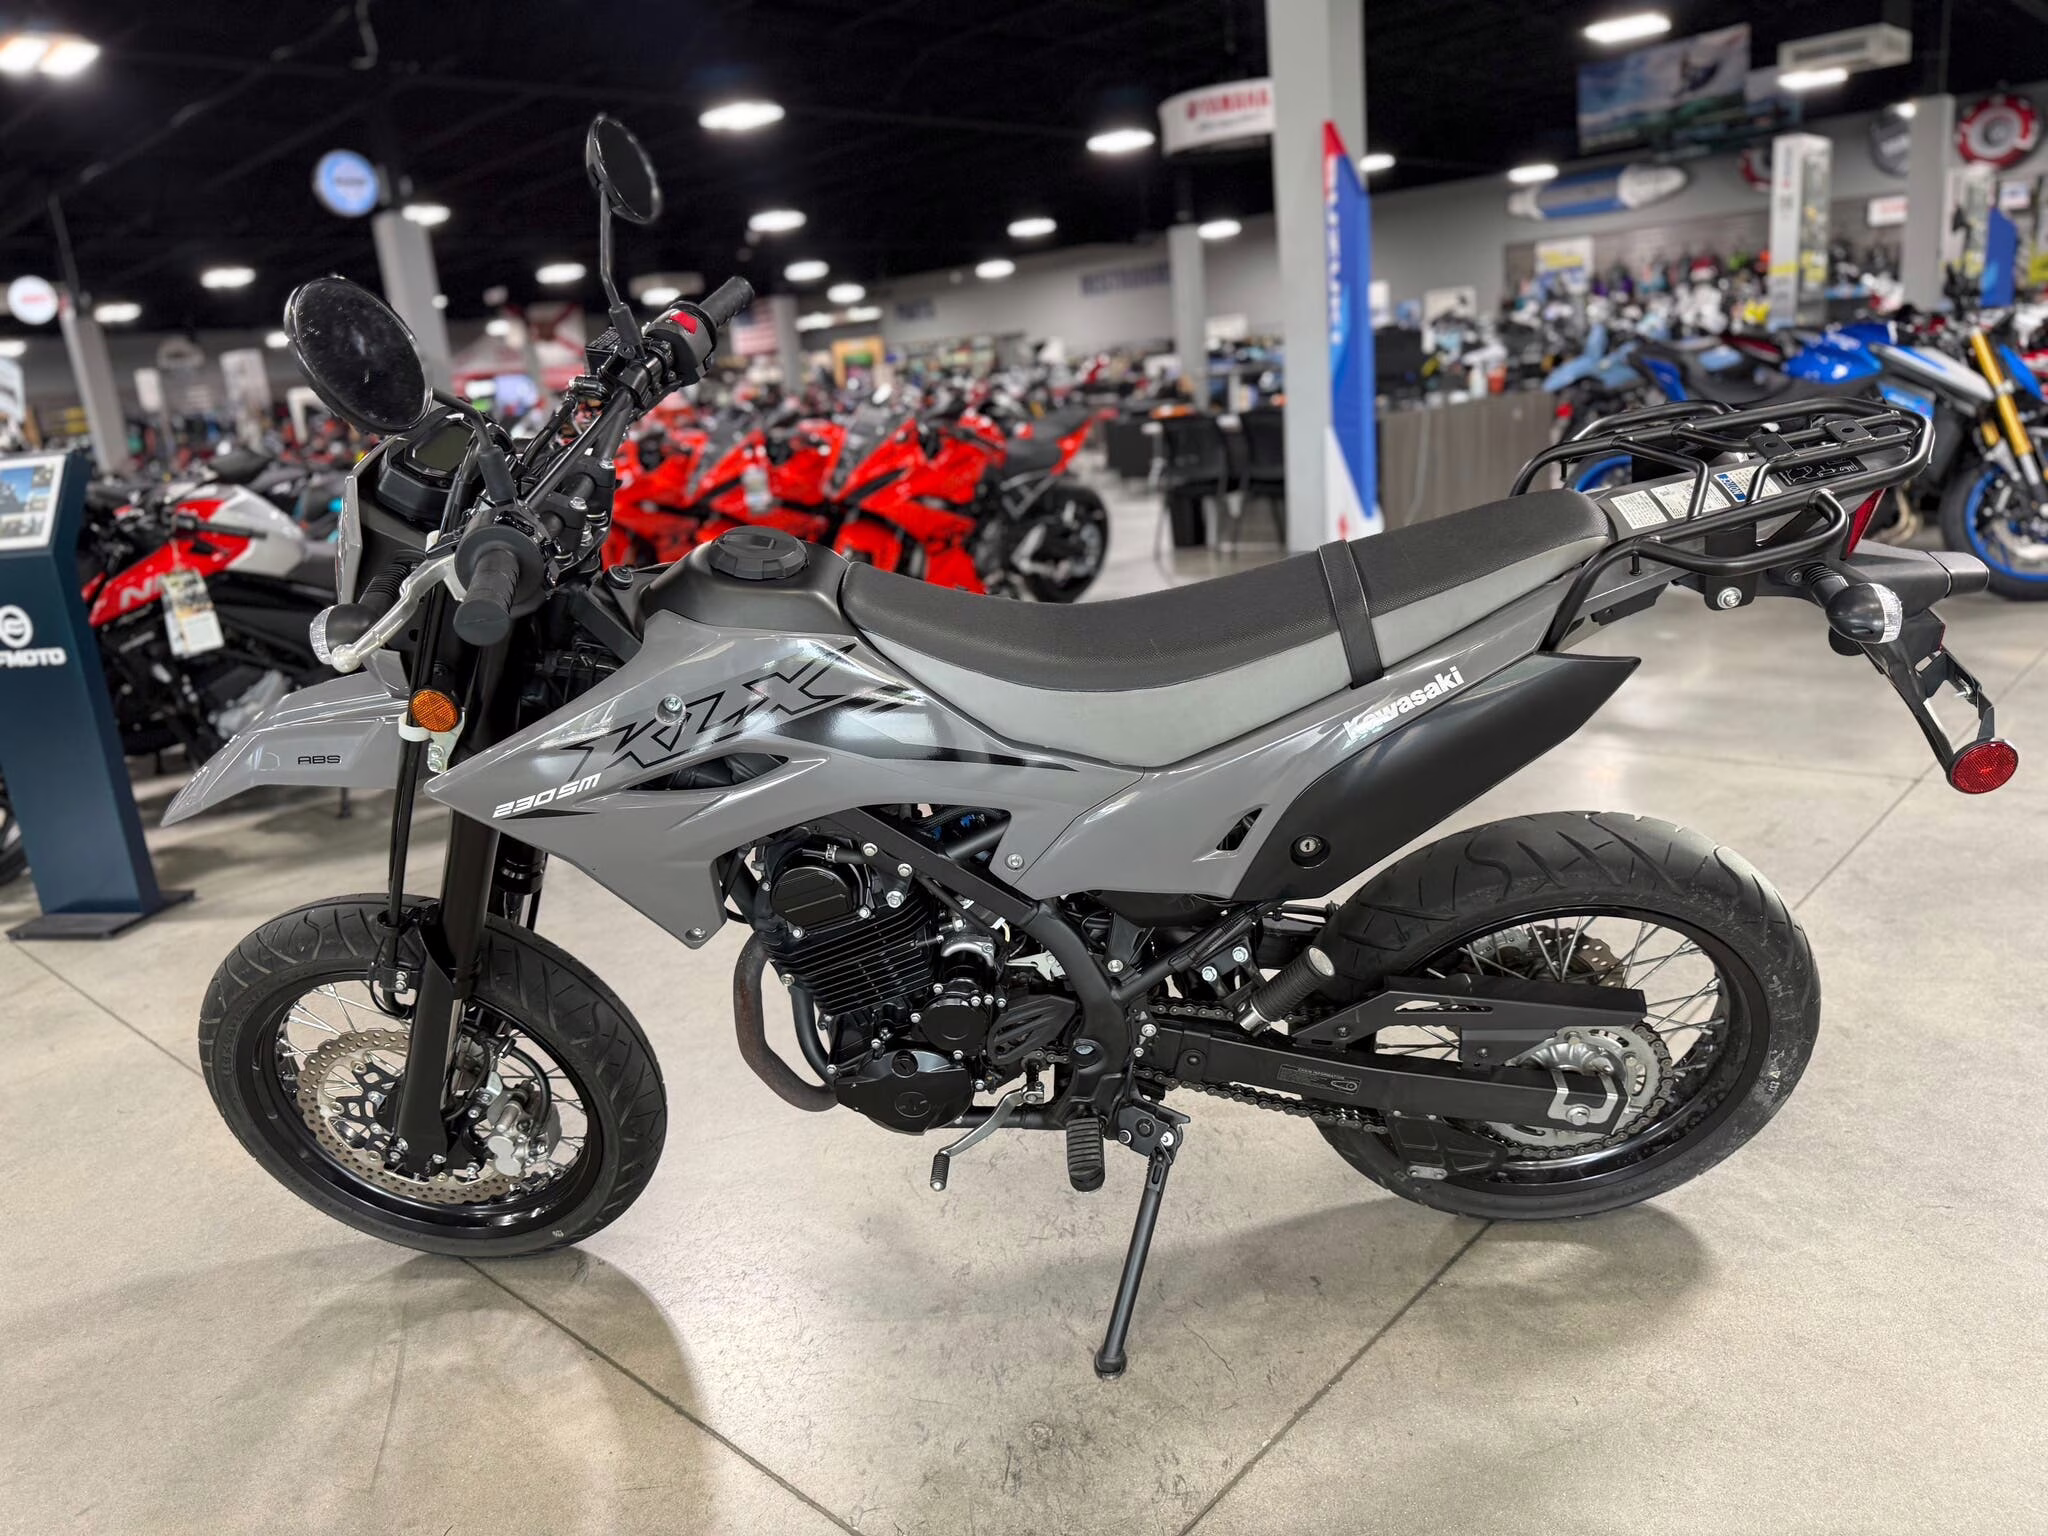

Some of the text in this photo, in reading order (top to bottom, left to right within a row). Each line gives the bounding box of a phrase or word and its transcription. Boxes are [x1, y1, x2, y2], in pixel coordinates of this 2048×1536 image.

[560, 643, 857, 781] KLX
[1343, 666, 1465, 742] Kawasaki
[297, 755, 341, 765] ABS
[492, 772, 602, 818] 230 SM
